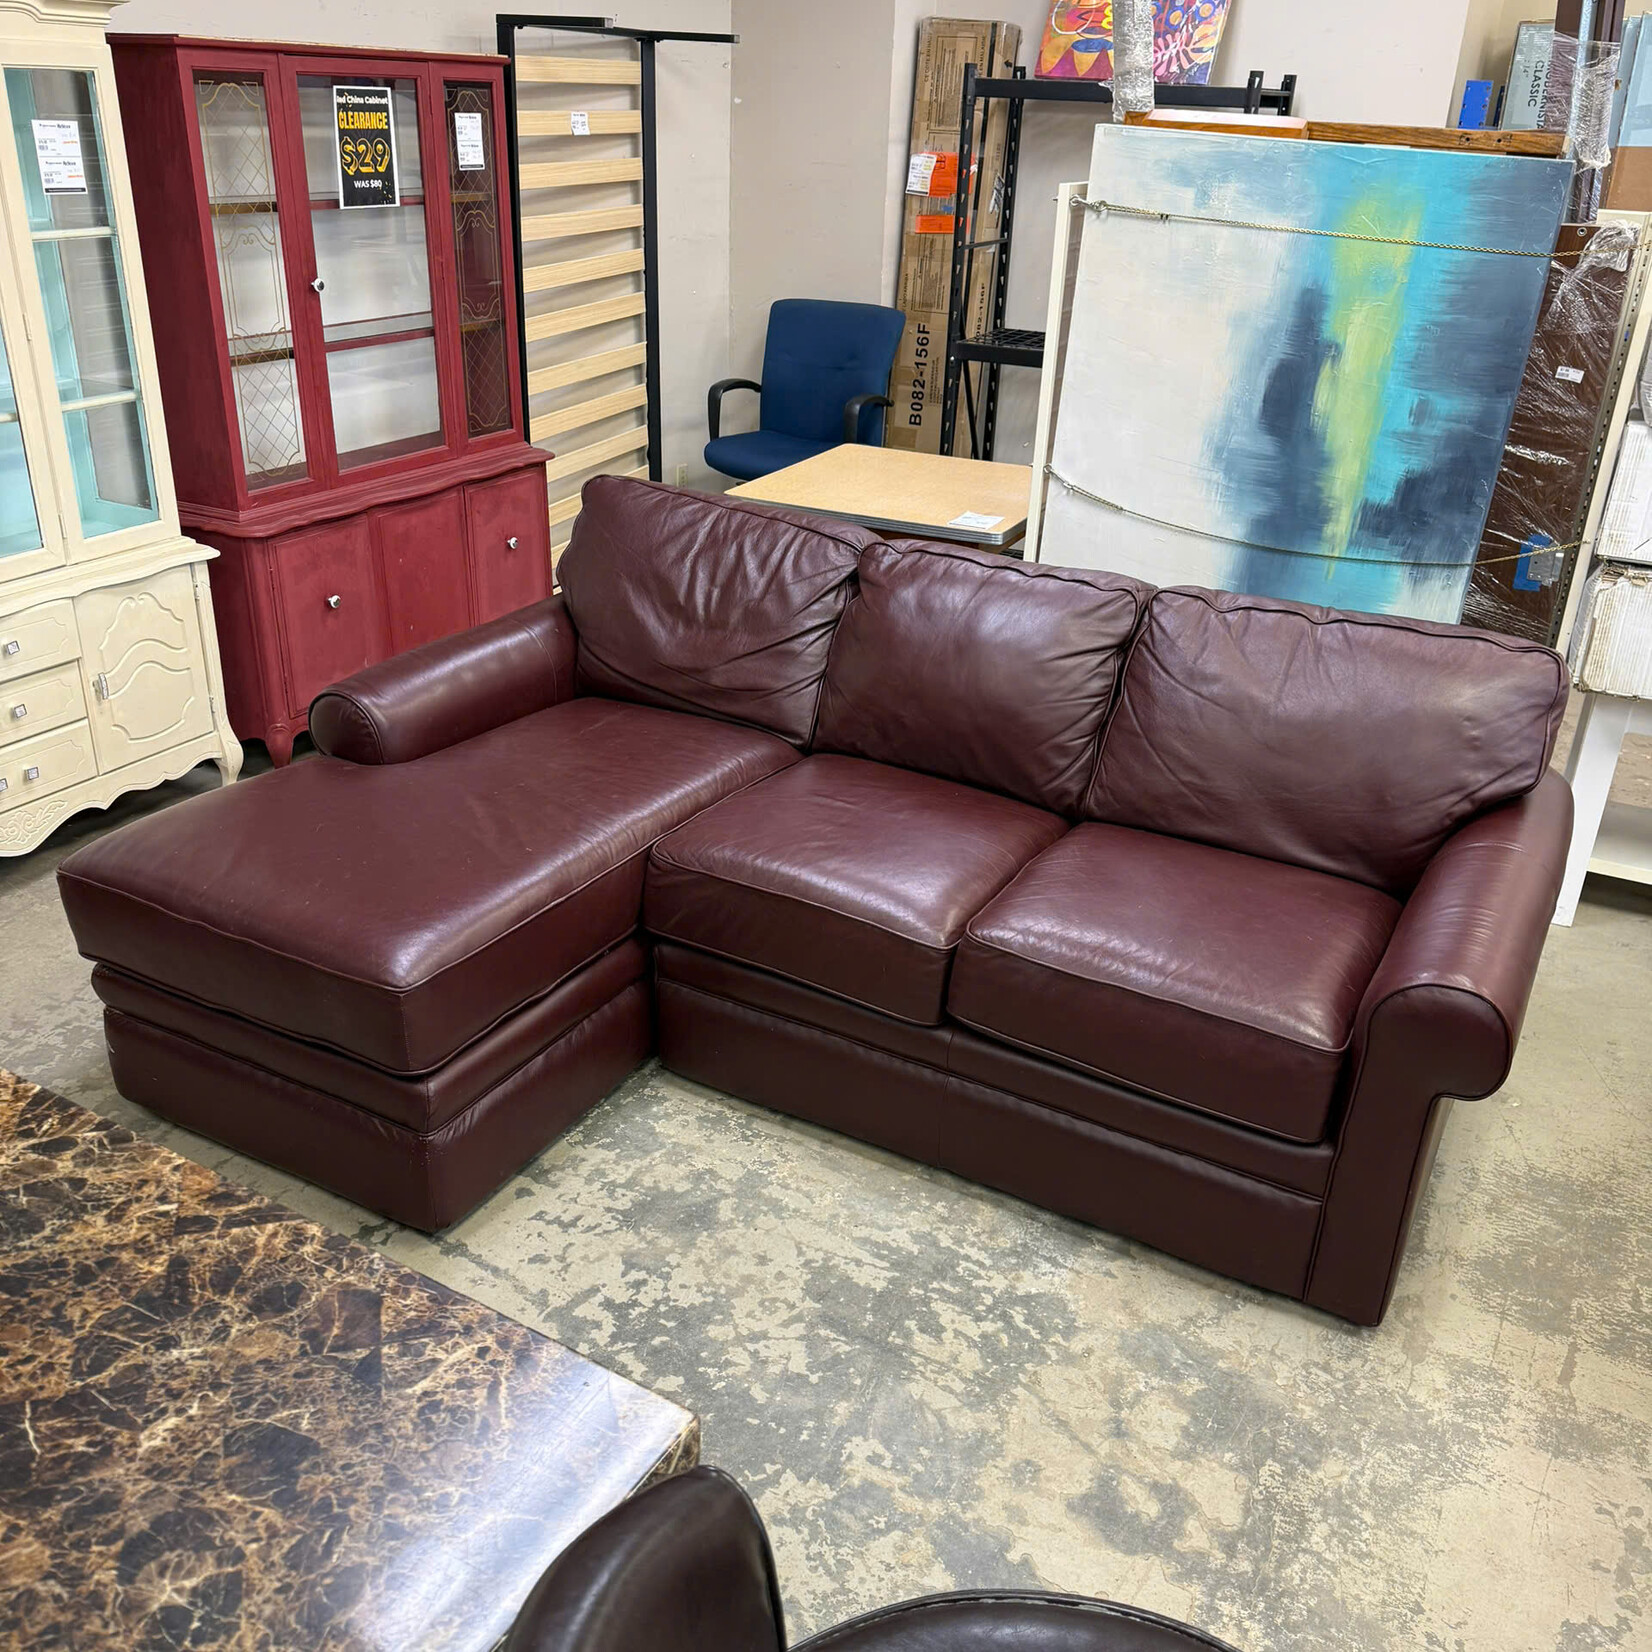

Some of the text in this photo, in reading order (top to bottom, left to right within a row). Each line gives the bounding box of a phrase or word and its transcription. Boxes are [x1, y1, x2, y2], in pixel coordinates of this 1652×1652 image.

[346, 95, 364, 104] China
[364, 95, 388, 104] Cabinet
[1528, 60, 1544, 107] CLASSIC
[338, 111, 388, 129] CLEARANCE
[341, 136, 390, 175] $29
[354, 179, 382, 188] WAS $80
[975, 283, 985, 338] 082-156F
[908, 323, 930, 426] B082-156F
